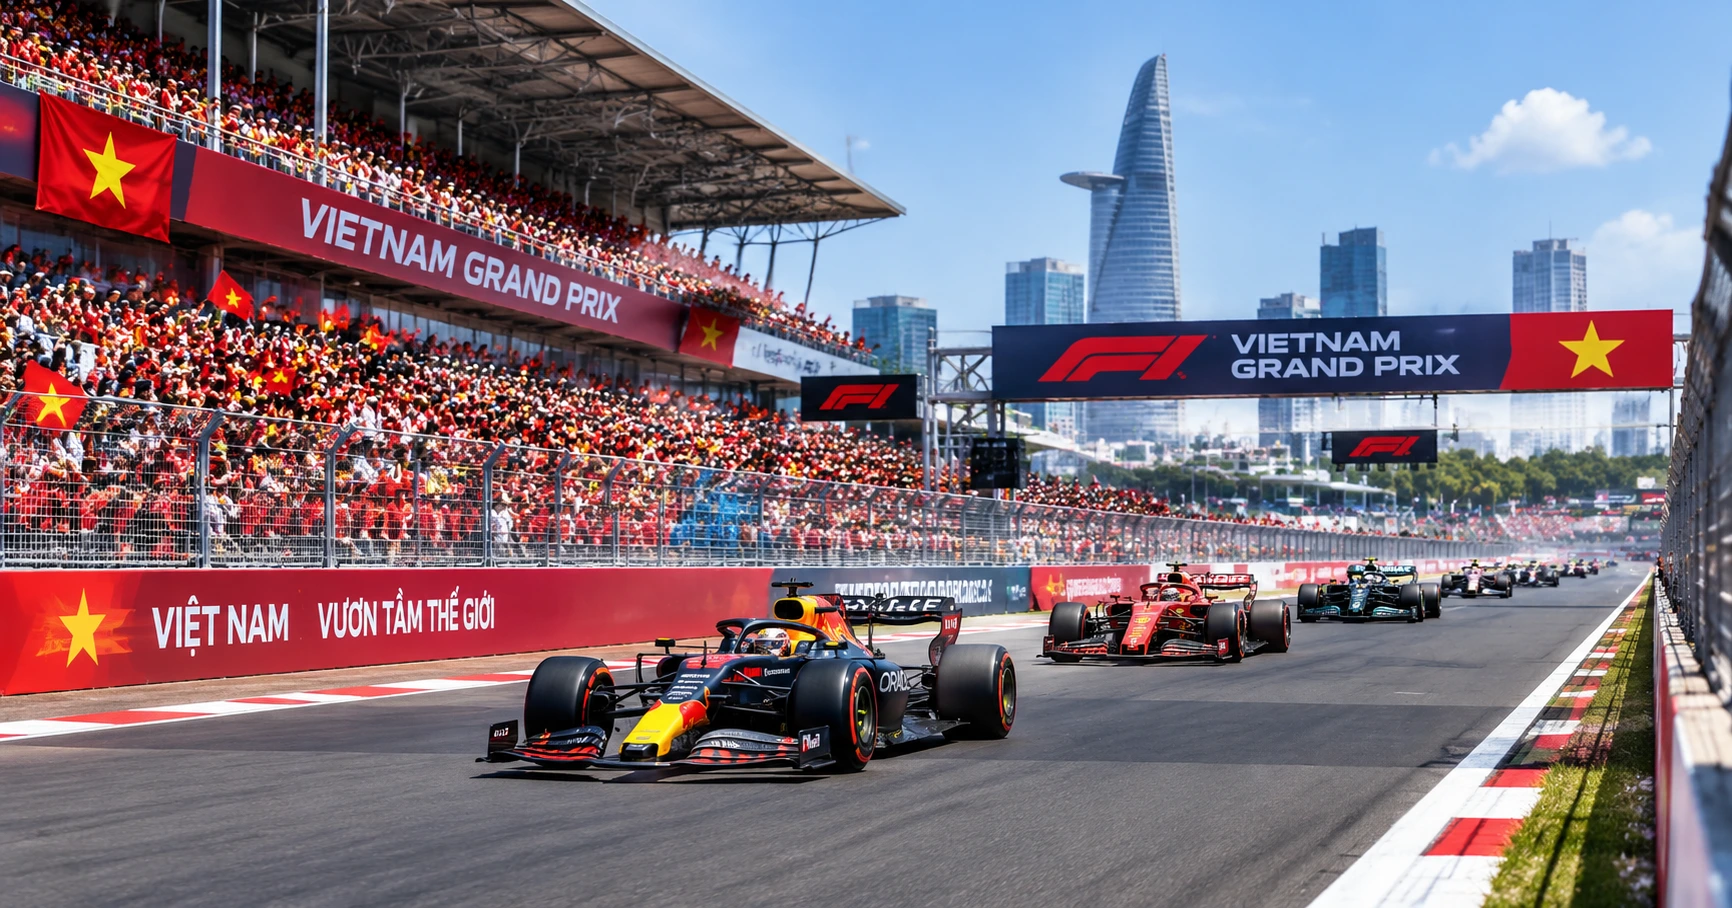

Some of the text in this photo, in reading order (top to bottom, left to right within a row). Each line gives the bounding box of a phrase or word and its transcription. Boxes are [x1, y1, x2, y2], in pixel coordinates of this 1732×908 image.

[301, 197, 622, 324] VIETNAM GRAND PRIX
[1230, 330, 1401, 355] VIETNAM
[1230, 354, 1461, 380] GRAND PRIX
[151, 584, 495, 658] VIỆT NAM VƯƠN TẦM THẾ GIỚI
